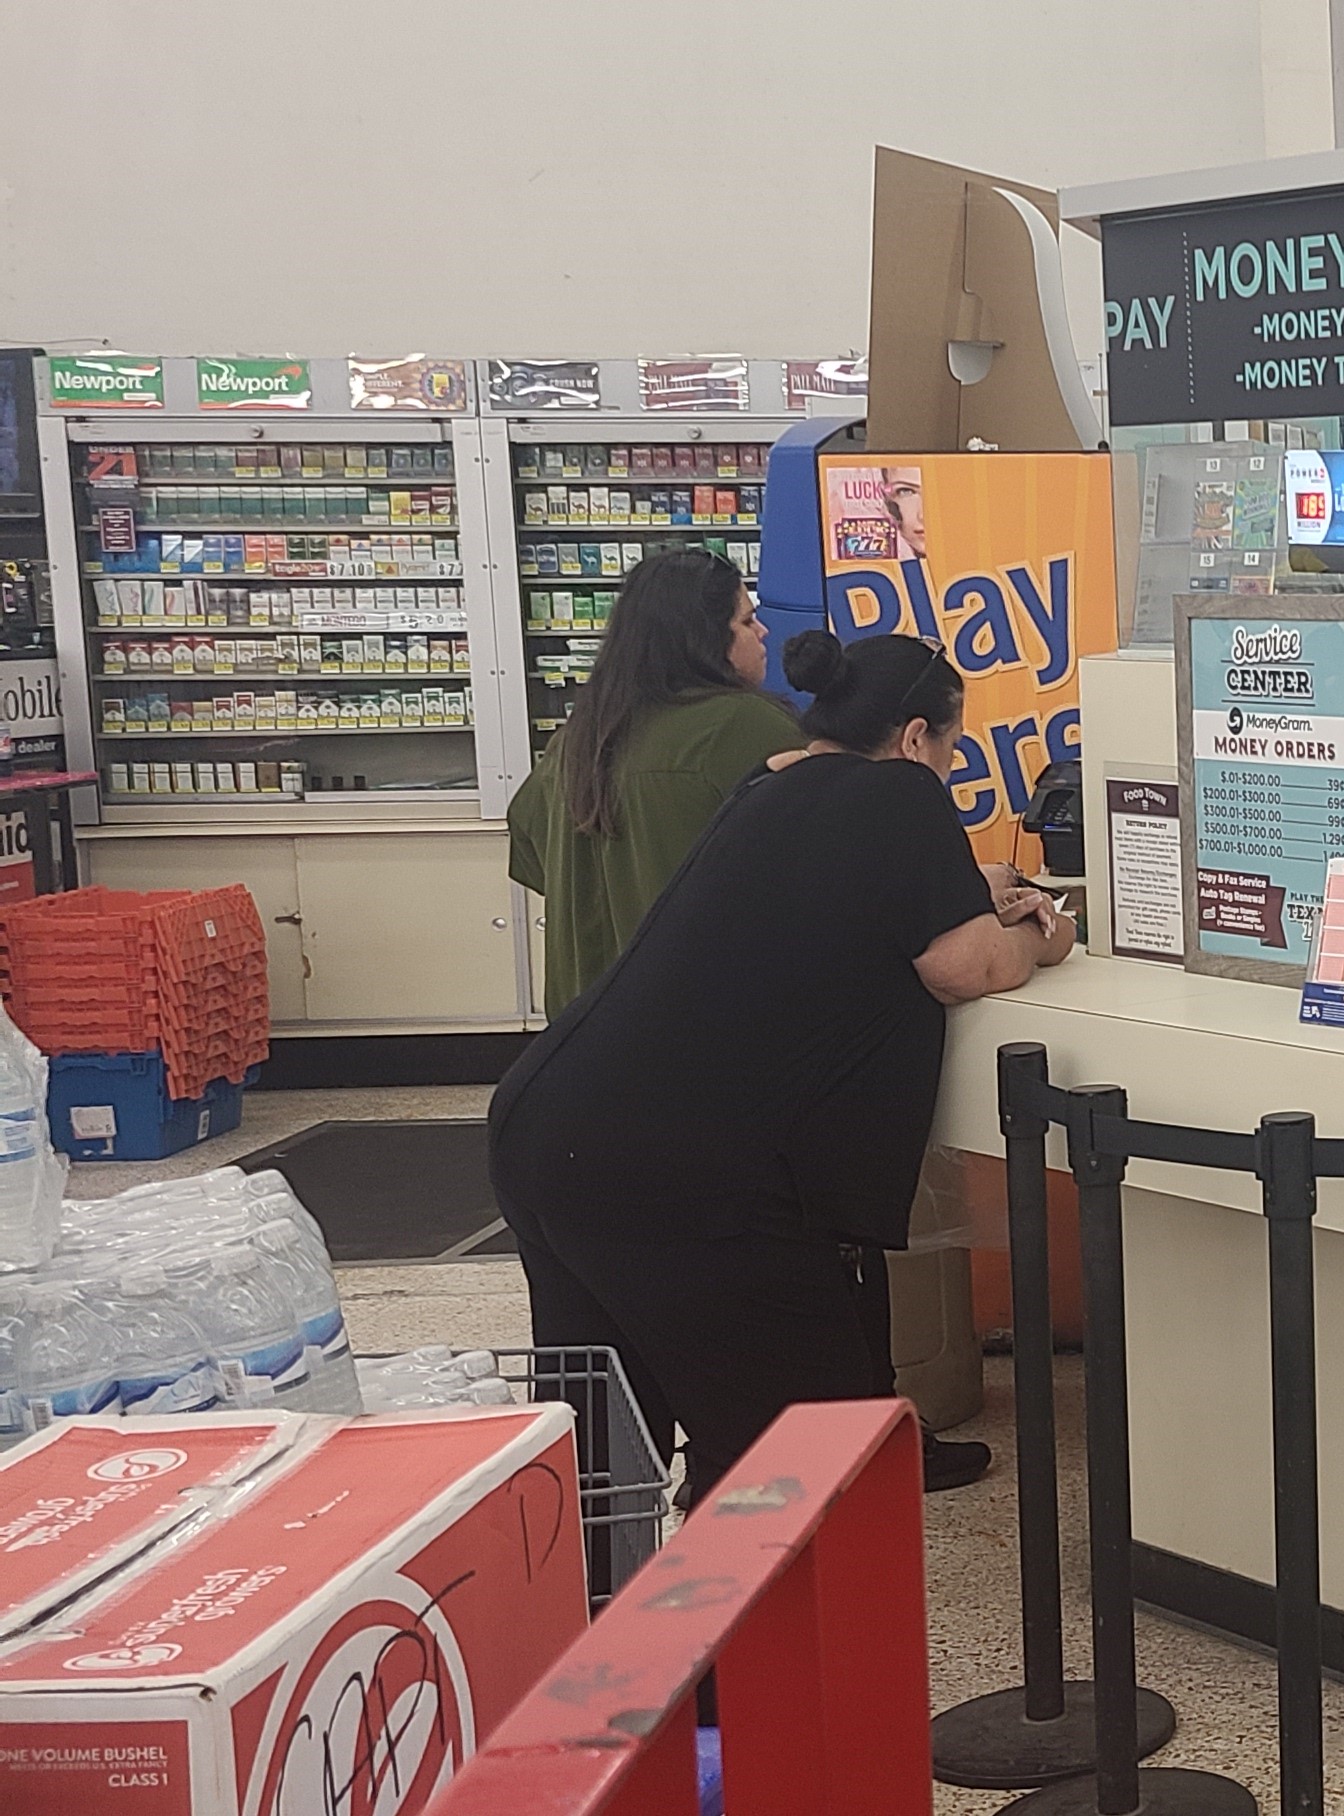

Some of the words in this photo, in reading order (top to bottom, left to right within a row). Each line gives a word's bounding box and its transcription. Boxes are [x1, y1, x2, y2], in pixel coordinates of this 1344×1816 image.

[1106, 295, 1175, 353] PAY
[55, 370, 144, 391] Newport
[201, 373, 289, 393] Newport
[826, 555, 1074, 690] Play
[1232, 626, 1300, 662] Service
[1226, 668, 1312, 695] CENTER
[1214, 736, 1268, 757] MONEY
[1274, 740, 1336, 761] ORDERS
[1327, 779, 1344, 792] 39¢
[1123, 787, 1145, 803] FOOD
[1144, 787, 1167, 806] TOWN
[1327, 797, 1344, 809] 69¢
[1149, 820, 1168, 830] POLICY
[1198, 871, 1217, 884] Copy
[1225, 875, 1238, 886] Fax
[1239, 876, 1266, 888] Service
[1200, 887, 1218, 898] Auto
[1220, 890, 1233, 902] Tag
[1234, 891, 1266, 904] Renewal
[1290, 892, 1308, 901] PLAY
[32, 1748, 100, 1762] VOLUME
[104, 1747, 168, 1761] BUSHEL
[108, 1773, 159, 1787] CLASS
[162, 1772, 169, 1786] 1
